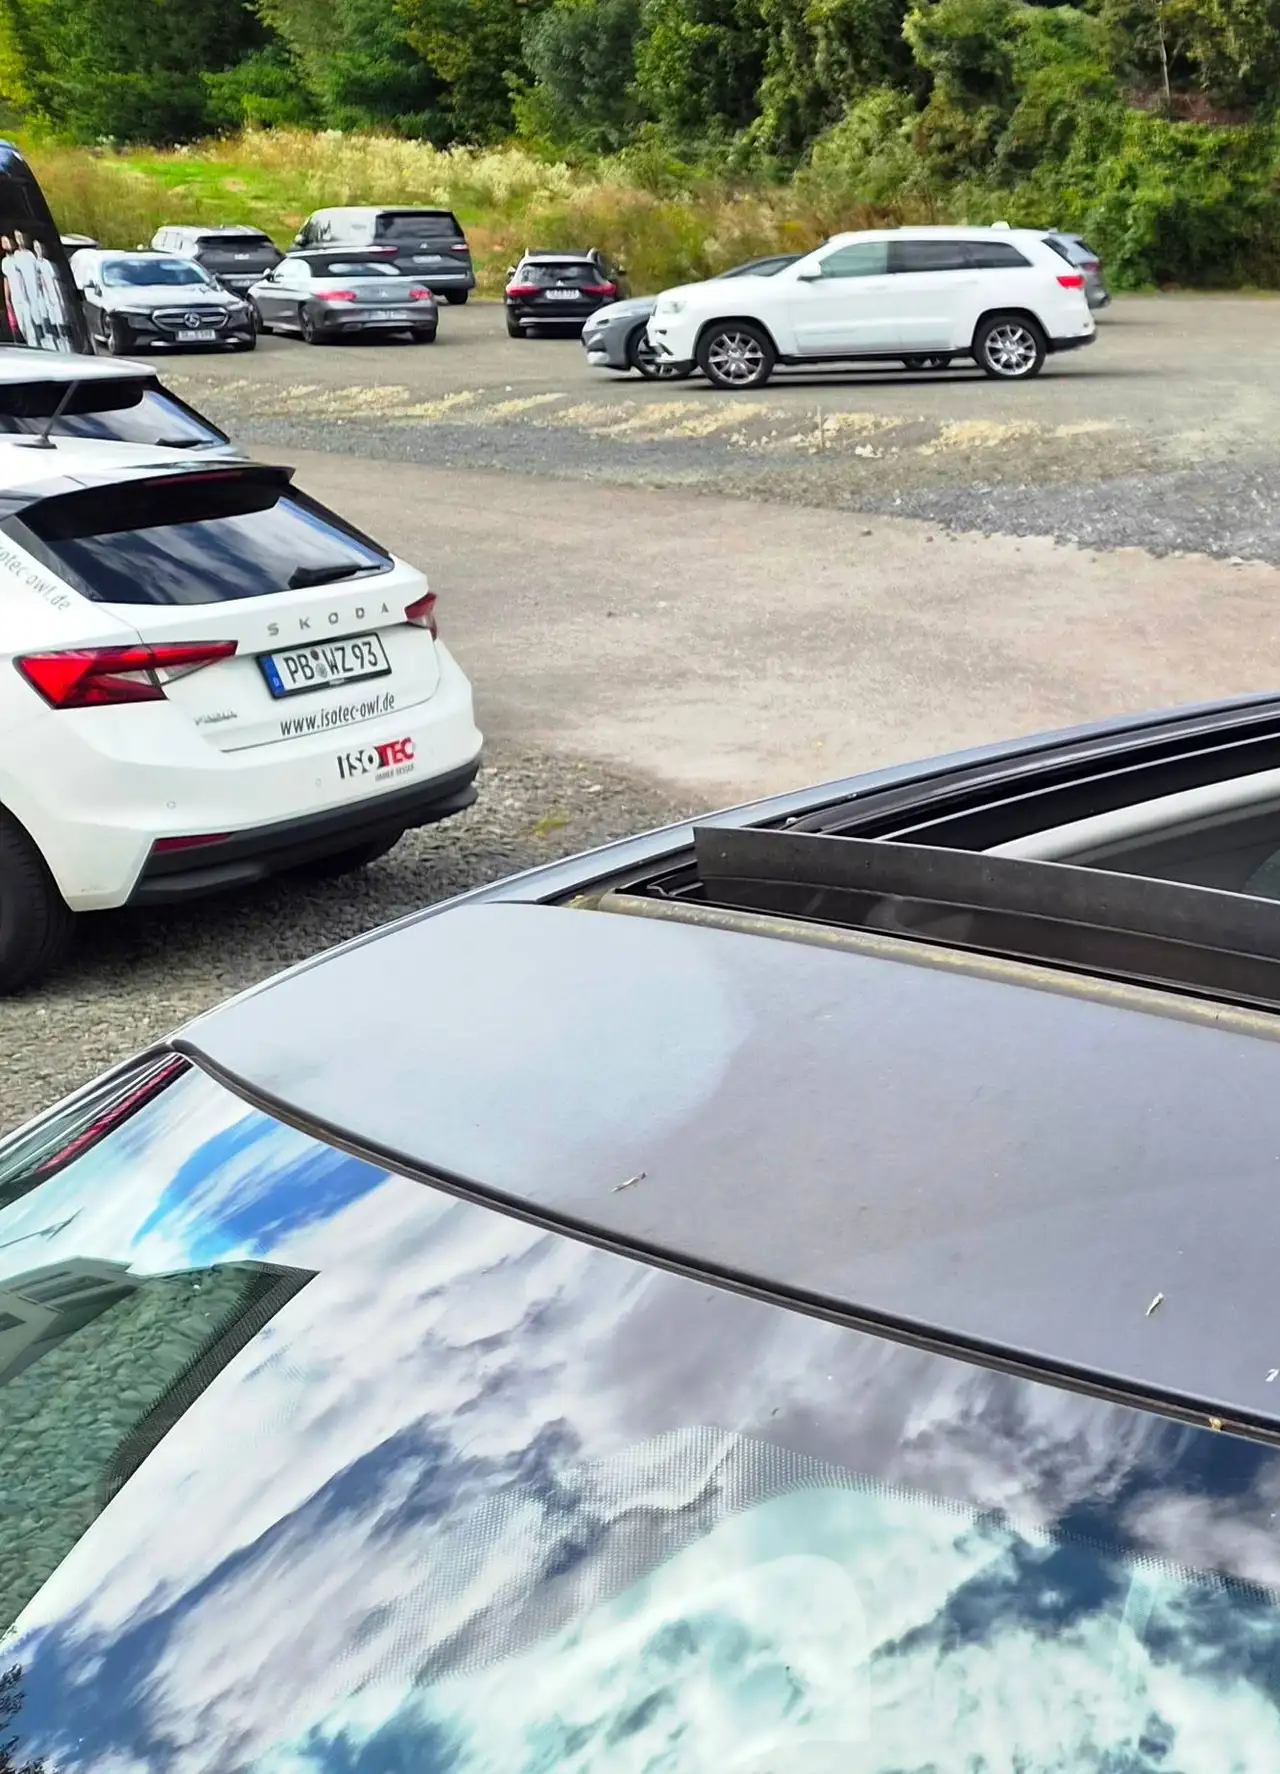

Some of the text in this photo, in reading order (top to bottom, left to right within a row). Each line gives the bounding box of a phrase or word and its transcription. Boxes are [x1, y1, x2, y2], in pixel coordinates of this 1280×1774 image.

[0, 546, 71, 611] otec-owl.de
[280, 692, 395, 736] www.isotec-owl.de
[337, 737, 416, 780] ISOTEC
